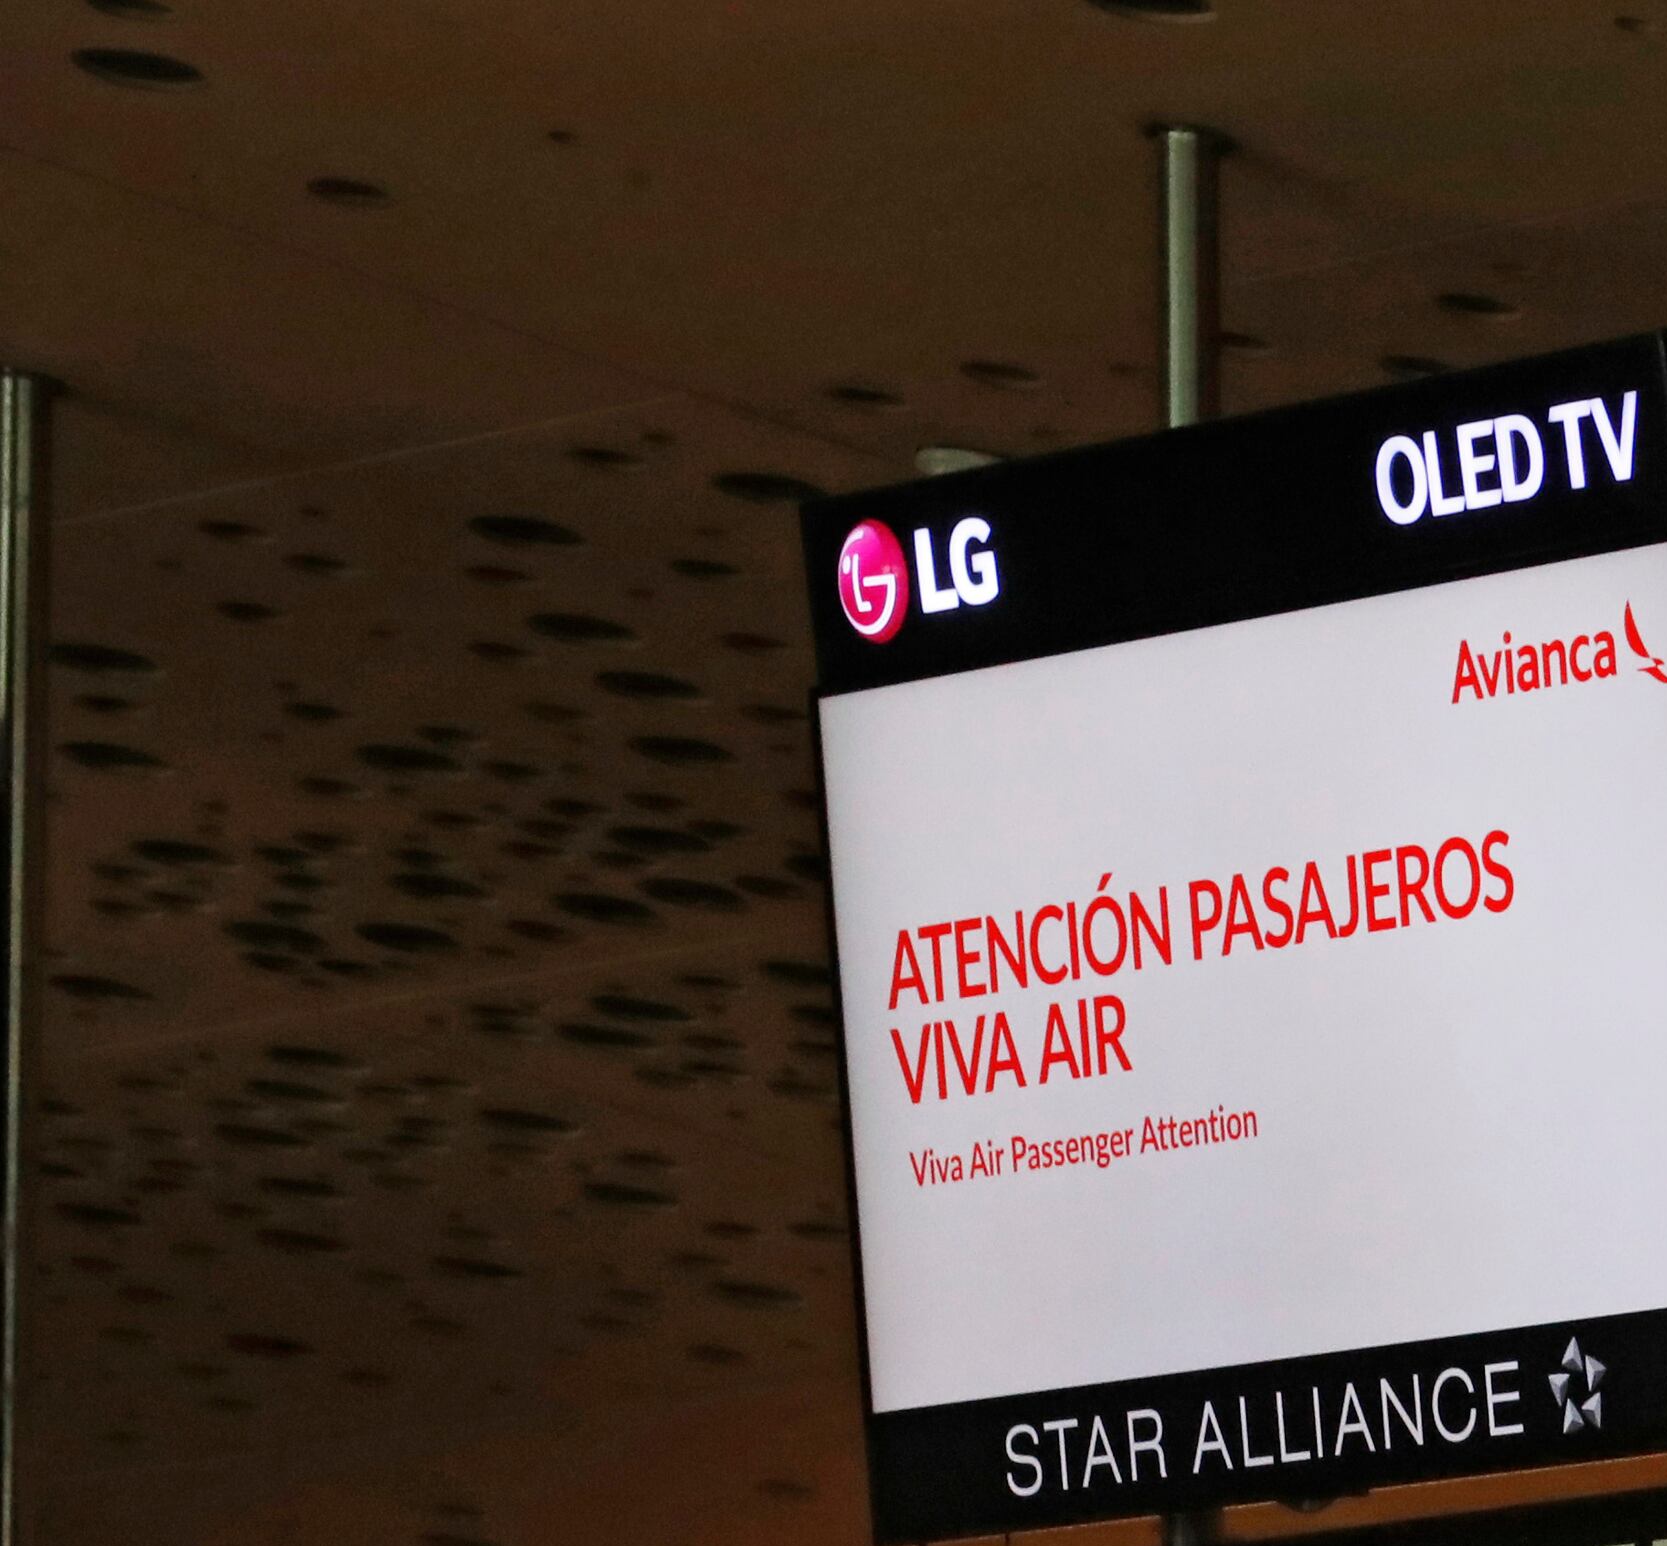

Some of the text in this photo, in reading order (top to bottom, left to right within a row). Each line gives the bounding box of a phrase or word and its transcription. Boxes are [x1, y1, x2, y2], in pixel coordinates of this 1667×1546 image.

[1376, 391, 1636, 524] OLED TV
[914, 518, 998, 613] LG
[1453, 631, 1617, 704] Avianca
[889, 830, 1515, 1009] ATENCIÓN PASAJEROS
[891, 994, 1133, 1105] VIVA AIR
[911, 1104, 1258, 1185] Viva Air Passenger Attention
[1006, 1361, 1523, 1496] STAR ALLIANCE
